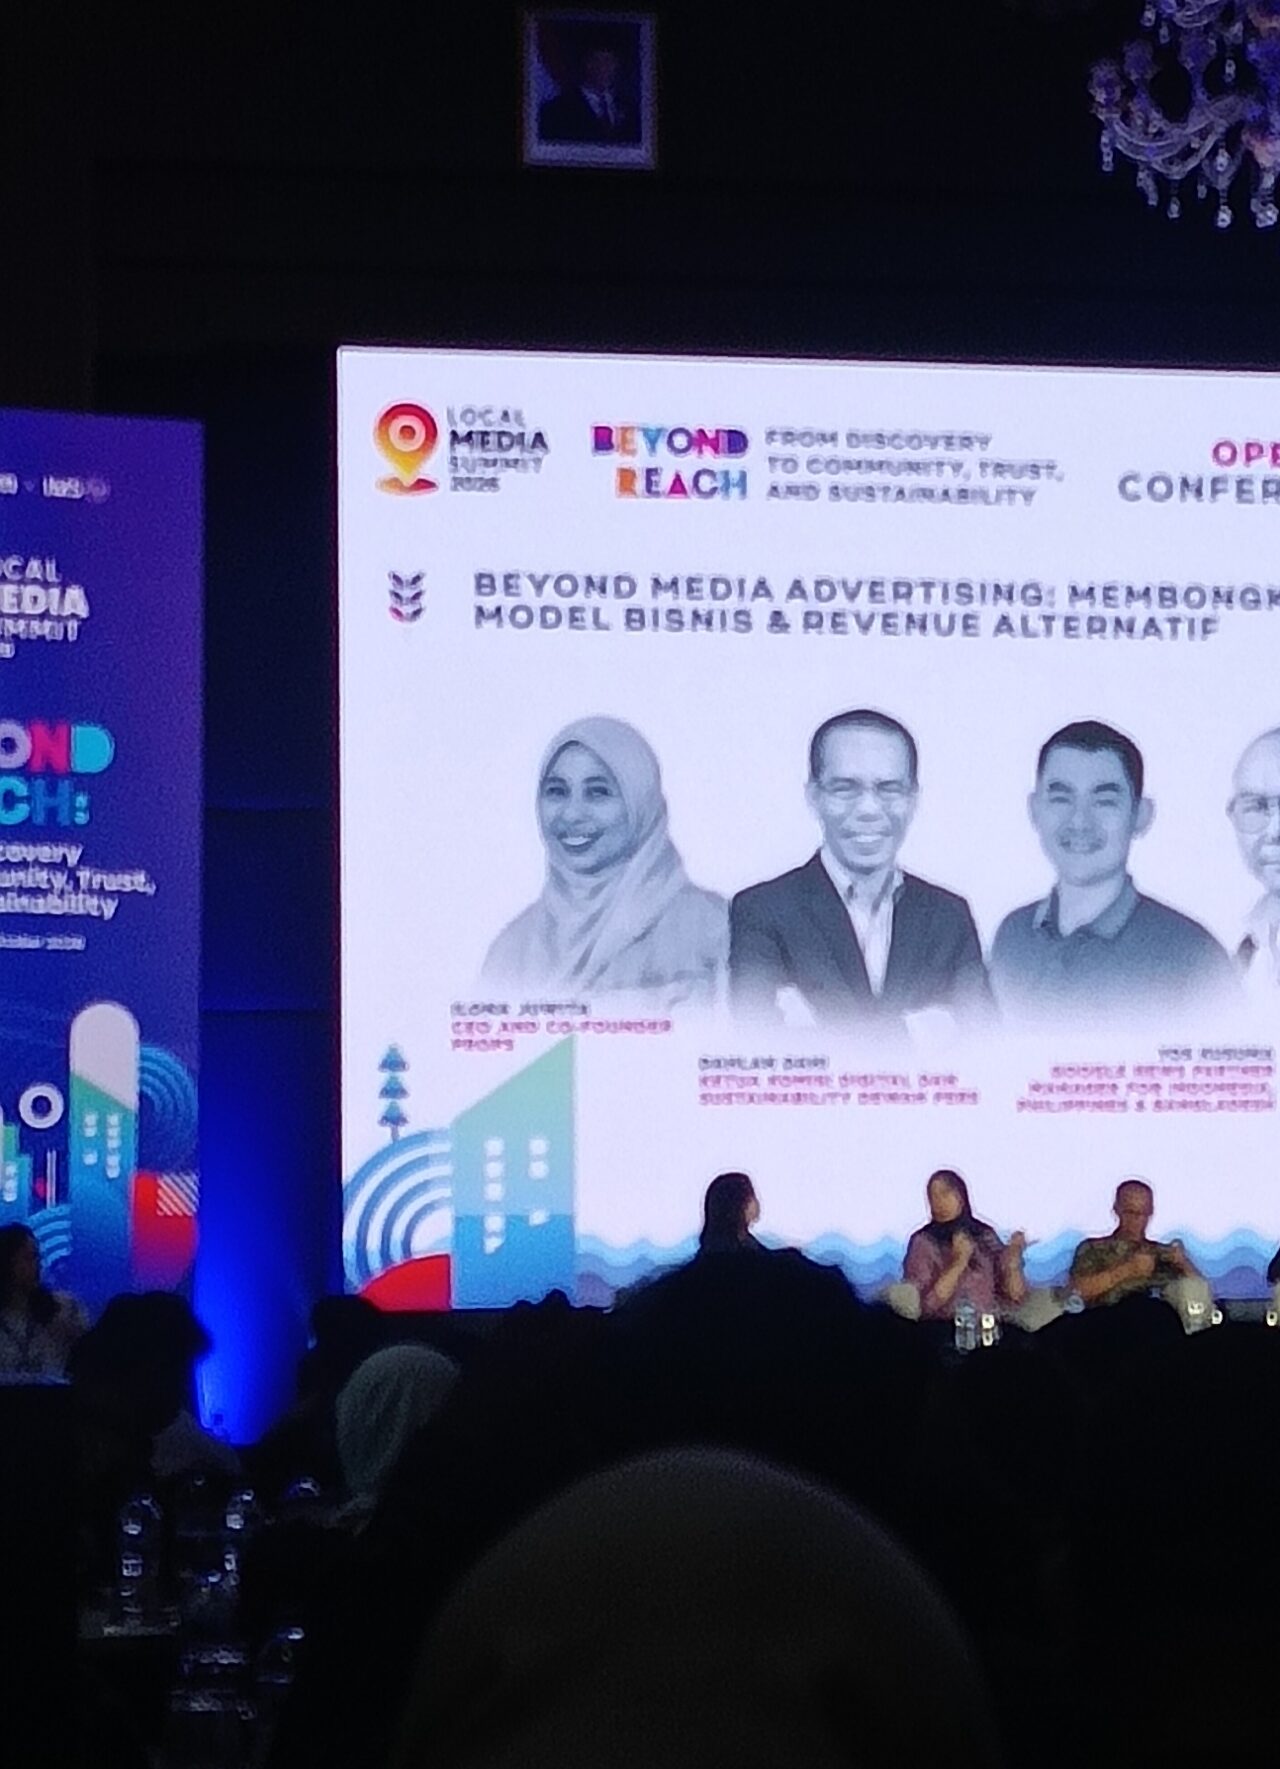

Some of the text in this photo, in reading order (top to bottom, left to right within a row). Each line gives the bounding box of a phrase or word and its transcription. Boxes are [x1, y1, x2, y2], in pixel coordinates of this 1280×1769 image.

[447, 405, 526, 428] LOCAL
[450, 428, 550, 455] MEDIA
[592, 424, 750, 457] BEYOND
[765, 430, 992, 450] FROM DISCOVERY
[616, 467, 748, 499] REACH
[767, 456, 1065, 482] TO COMMUNITY, TRUST,
[767, 484, 1036, 505] AND SUSTAINABILITY
[0, 554, 62, 582] CAL
[0, 584, 89, 618] EDIA
[474, 573, 638, 599] BEYOND
[651, 576, 774, 601] MEDIA
[786, 577, 1055, 608] ADVERTISING:
[474, 605, 1221, 640] MODEL BISNIS & REVENUE ALTERNATIF
[0, 720, 115, 774] OND
[0, 775, 90, 826] CH:
[499, 1020, 539, 1034] AND
